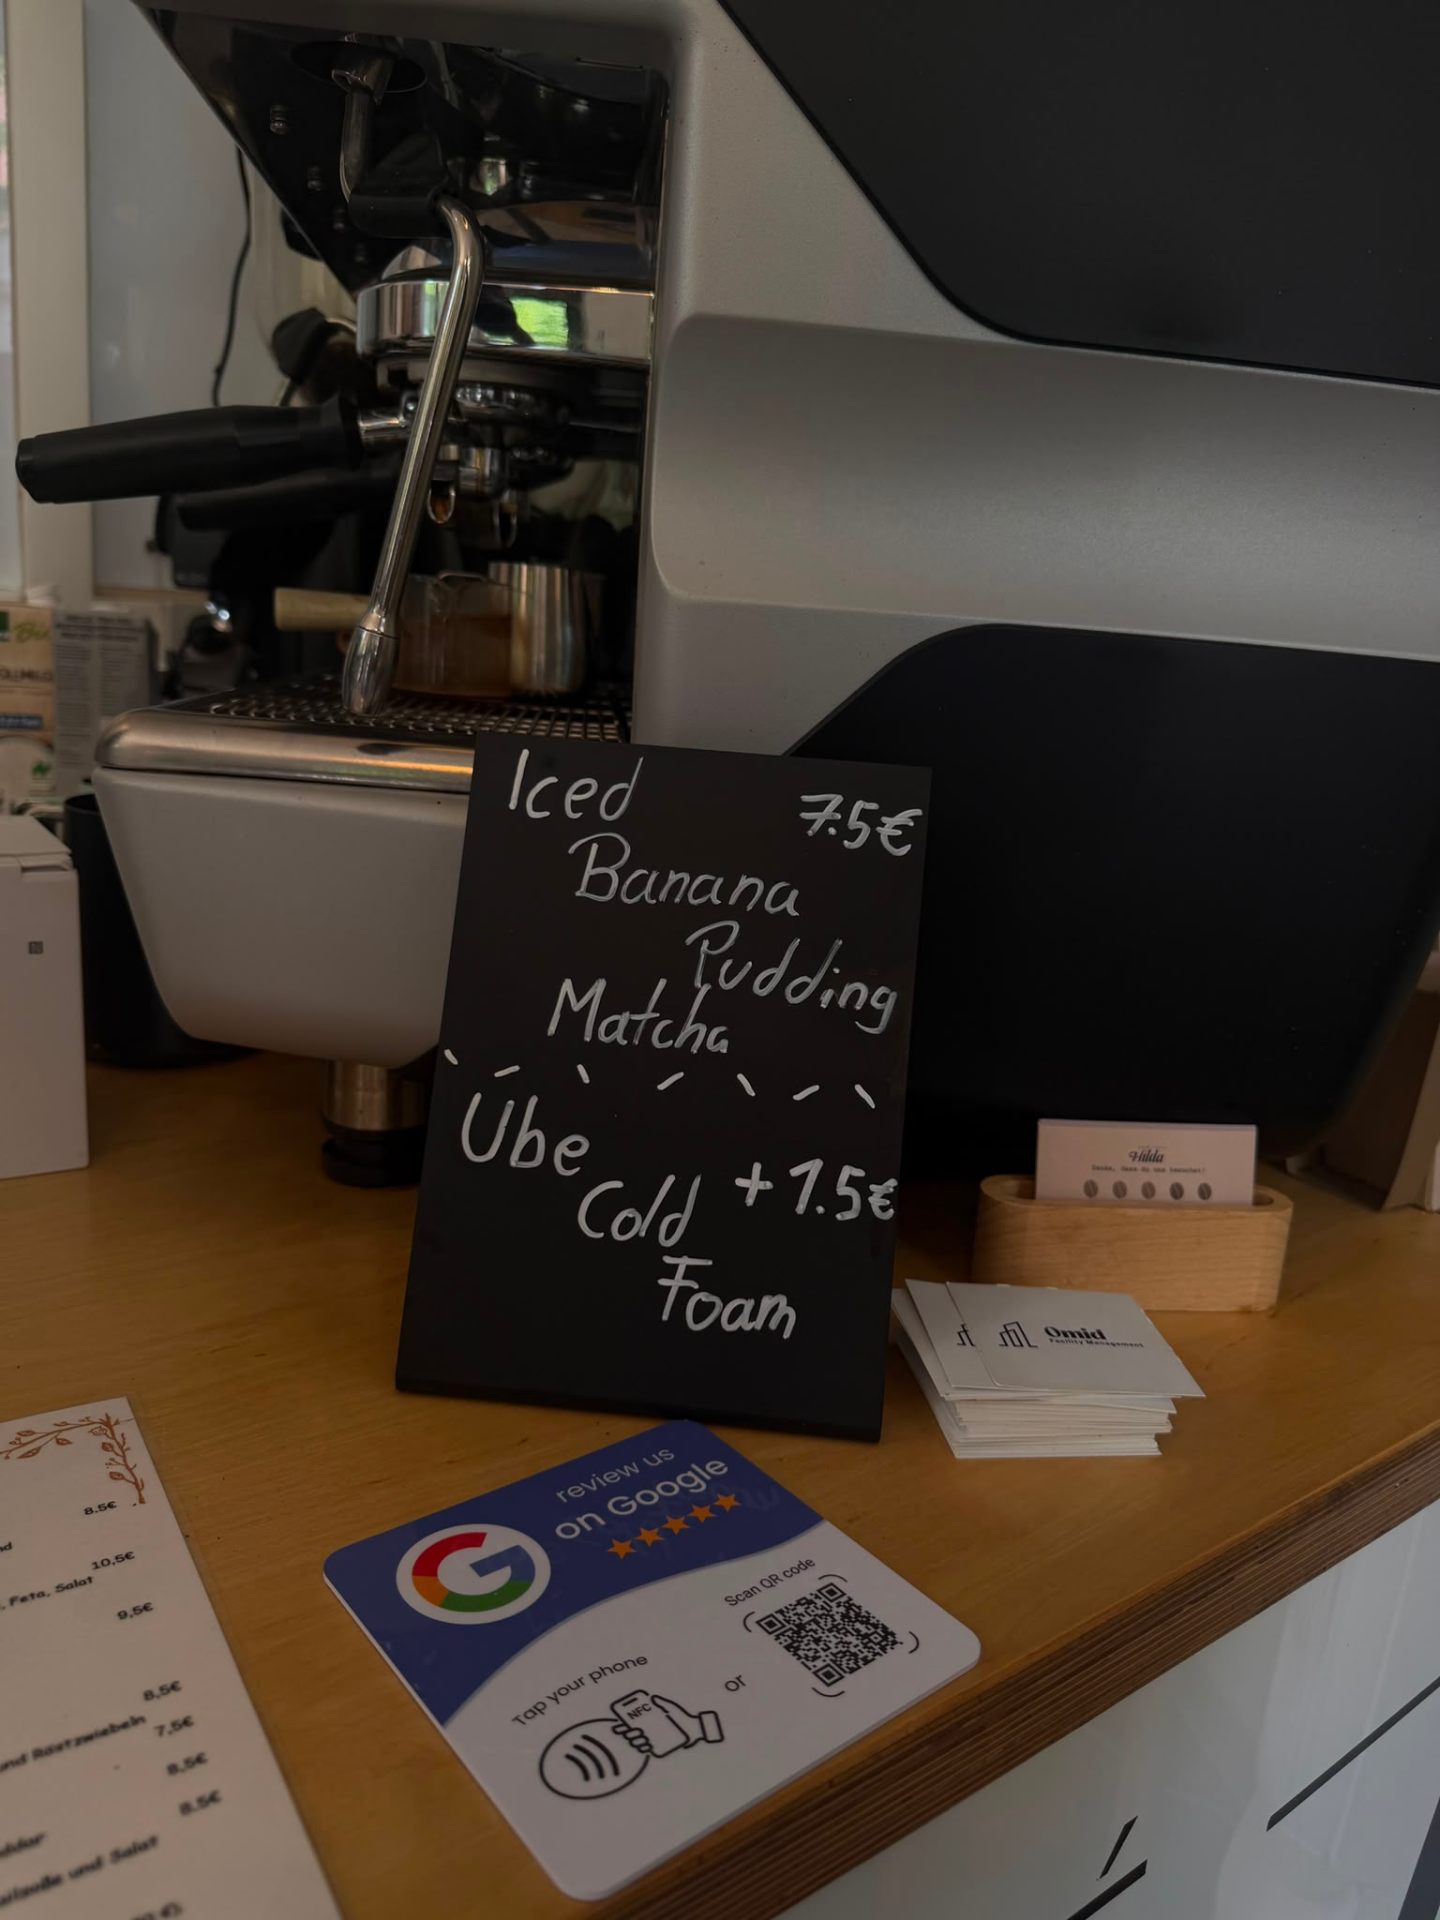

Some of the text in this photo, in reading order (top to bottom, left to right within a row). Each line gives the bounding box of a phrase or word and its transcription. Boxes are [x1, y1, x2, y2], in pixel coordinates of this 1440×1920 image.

[508, 748, 644, 821] Iced
[800, 793, 923, 856] 7.5€
[568, 832, 800, 917] Banana
[685, 920, 897, 1035] Pudding
[547, 977, 730, 1054] Matcha
[461, 1092, 590, 1176] Ube
[1129, 1149, 1165, 1163] Hilda
[577, 1174, 701, 1247] Cold
[657, 1255, 797, 1340] Foam
[1044, 1326, 1106, 1340] Omid
[1085, 1339, 1144, 1348] Management
[555, 1460, 729, 1539] on Google
[556, 1448, 675, 1503] review us
[55, 1576, 94, 1593] Salat
[724, 1559, 816, 1606] Scan QR code
[512, 1656, 648, 1727] Tap your phone
[627, 1703, 652, 1720] NFC
[724, 1675, 747, 1692] or
